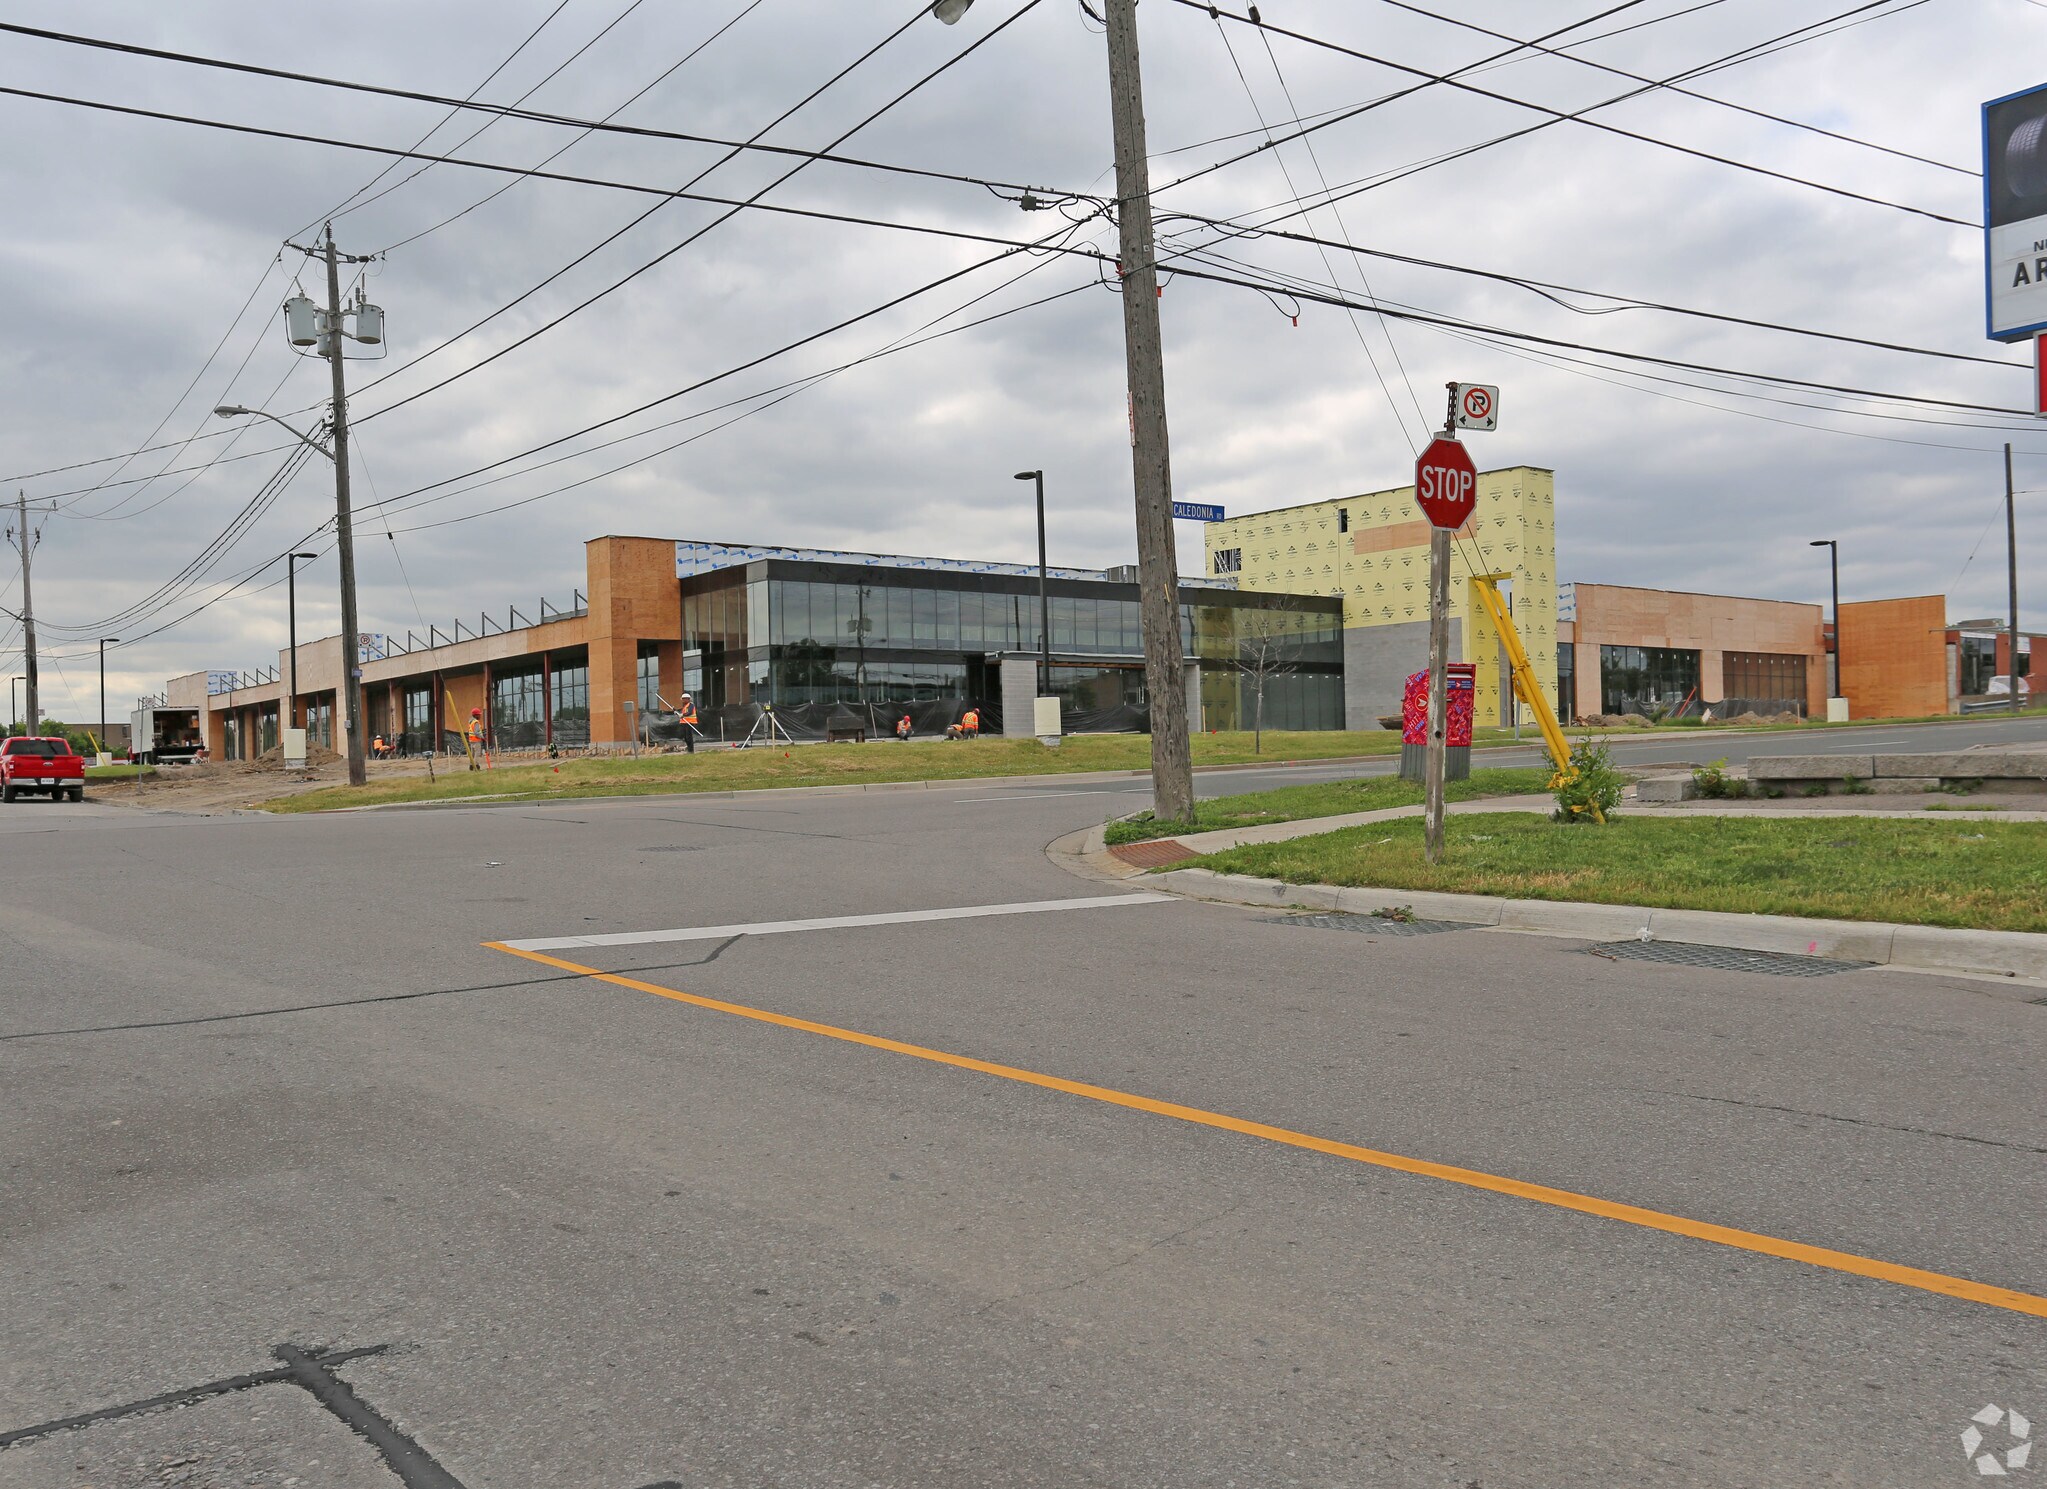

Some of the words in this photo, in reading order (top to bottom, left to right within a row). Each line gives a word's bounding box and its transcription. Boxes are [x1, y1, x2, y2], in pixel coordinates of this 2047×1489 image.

[2034, 239, 2047, 252] N
[1421, 465, 1472, 503] STOP
[1173, 504, 1214, 519] CALEDONIA
